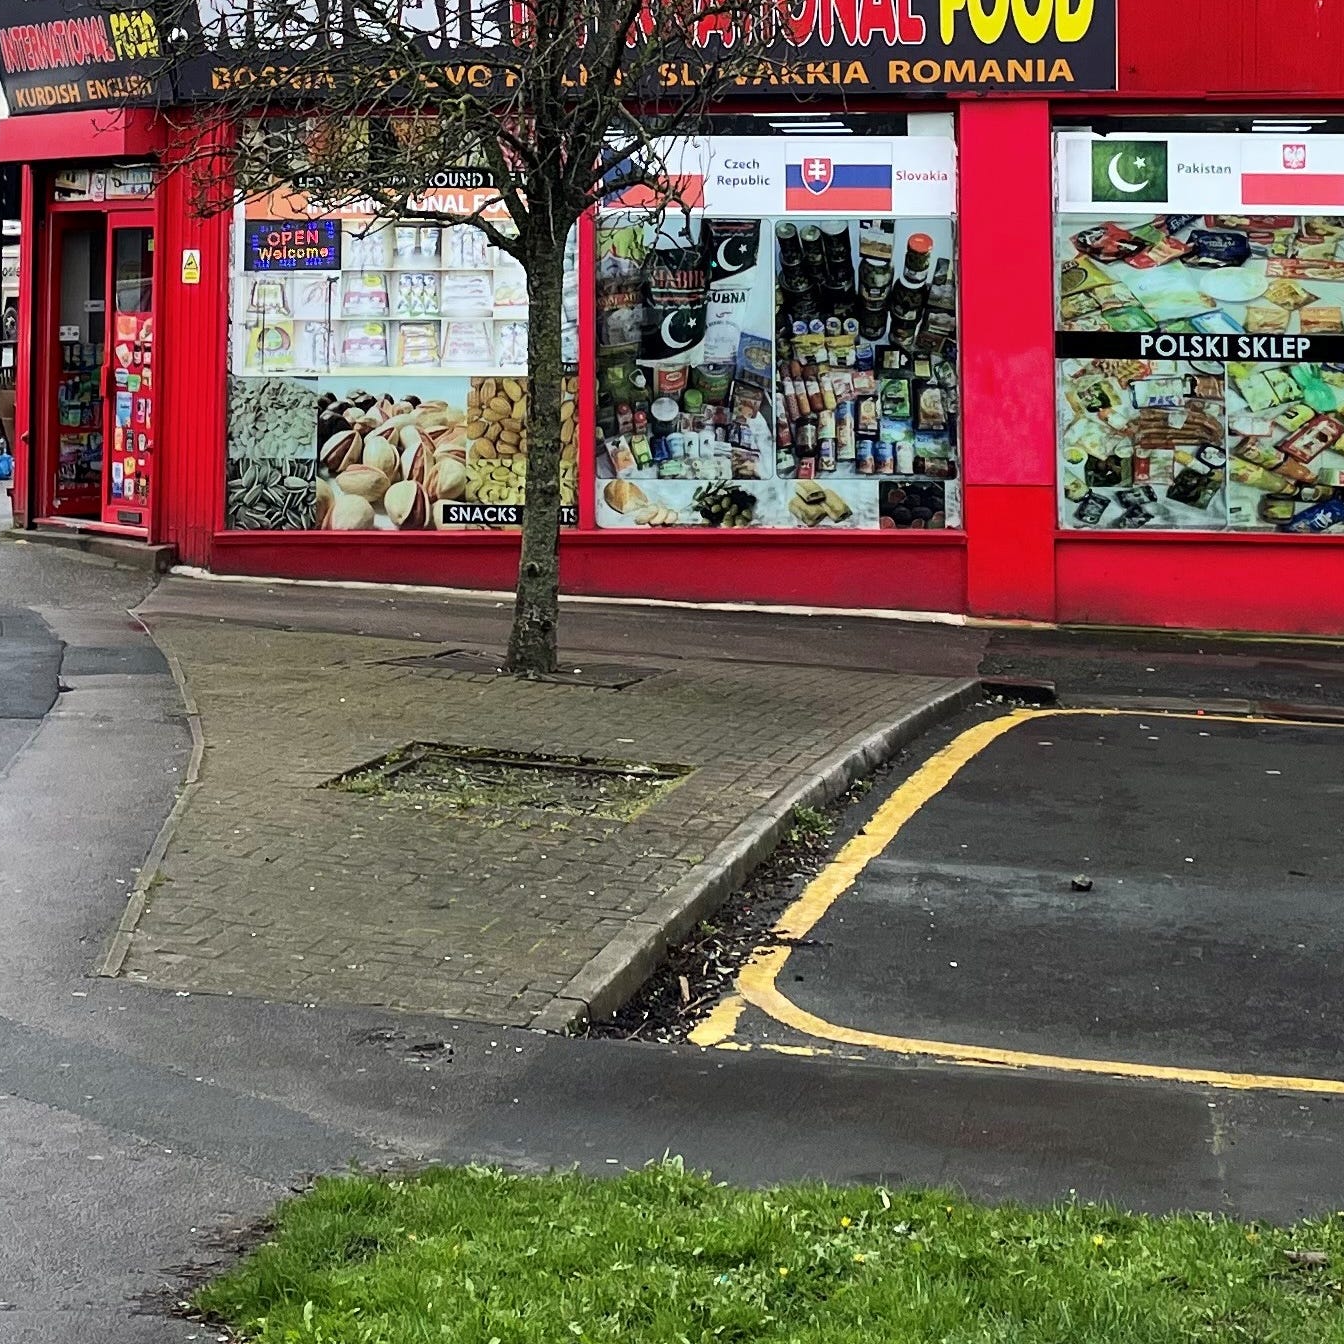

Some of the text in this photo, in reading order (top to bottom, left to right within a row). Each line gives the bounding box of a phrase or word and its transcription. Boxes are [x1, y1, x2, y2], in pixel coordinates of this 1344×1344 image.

[889, 58, 1075, 84] ROMANIA
[16, 75, 153, 108] KURDISH ENGLISH
[723, 158, 760, 170] Czech
[1176, 162, 1232, 175] Pakistan
[716, 173, 771, 187] Republic
[896, 169, 949, 182] Slovakia
[267, 230, 319, 247] OPEN
[258, 245, 329, 262] Welcome
[1140, 335, 1311, 359] POLSKI SKLEP
[449, 506, 517, 523] SNACKS
